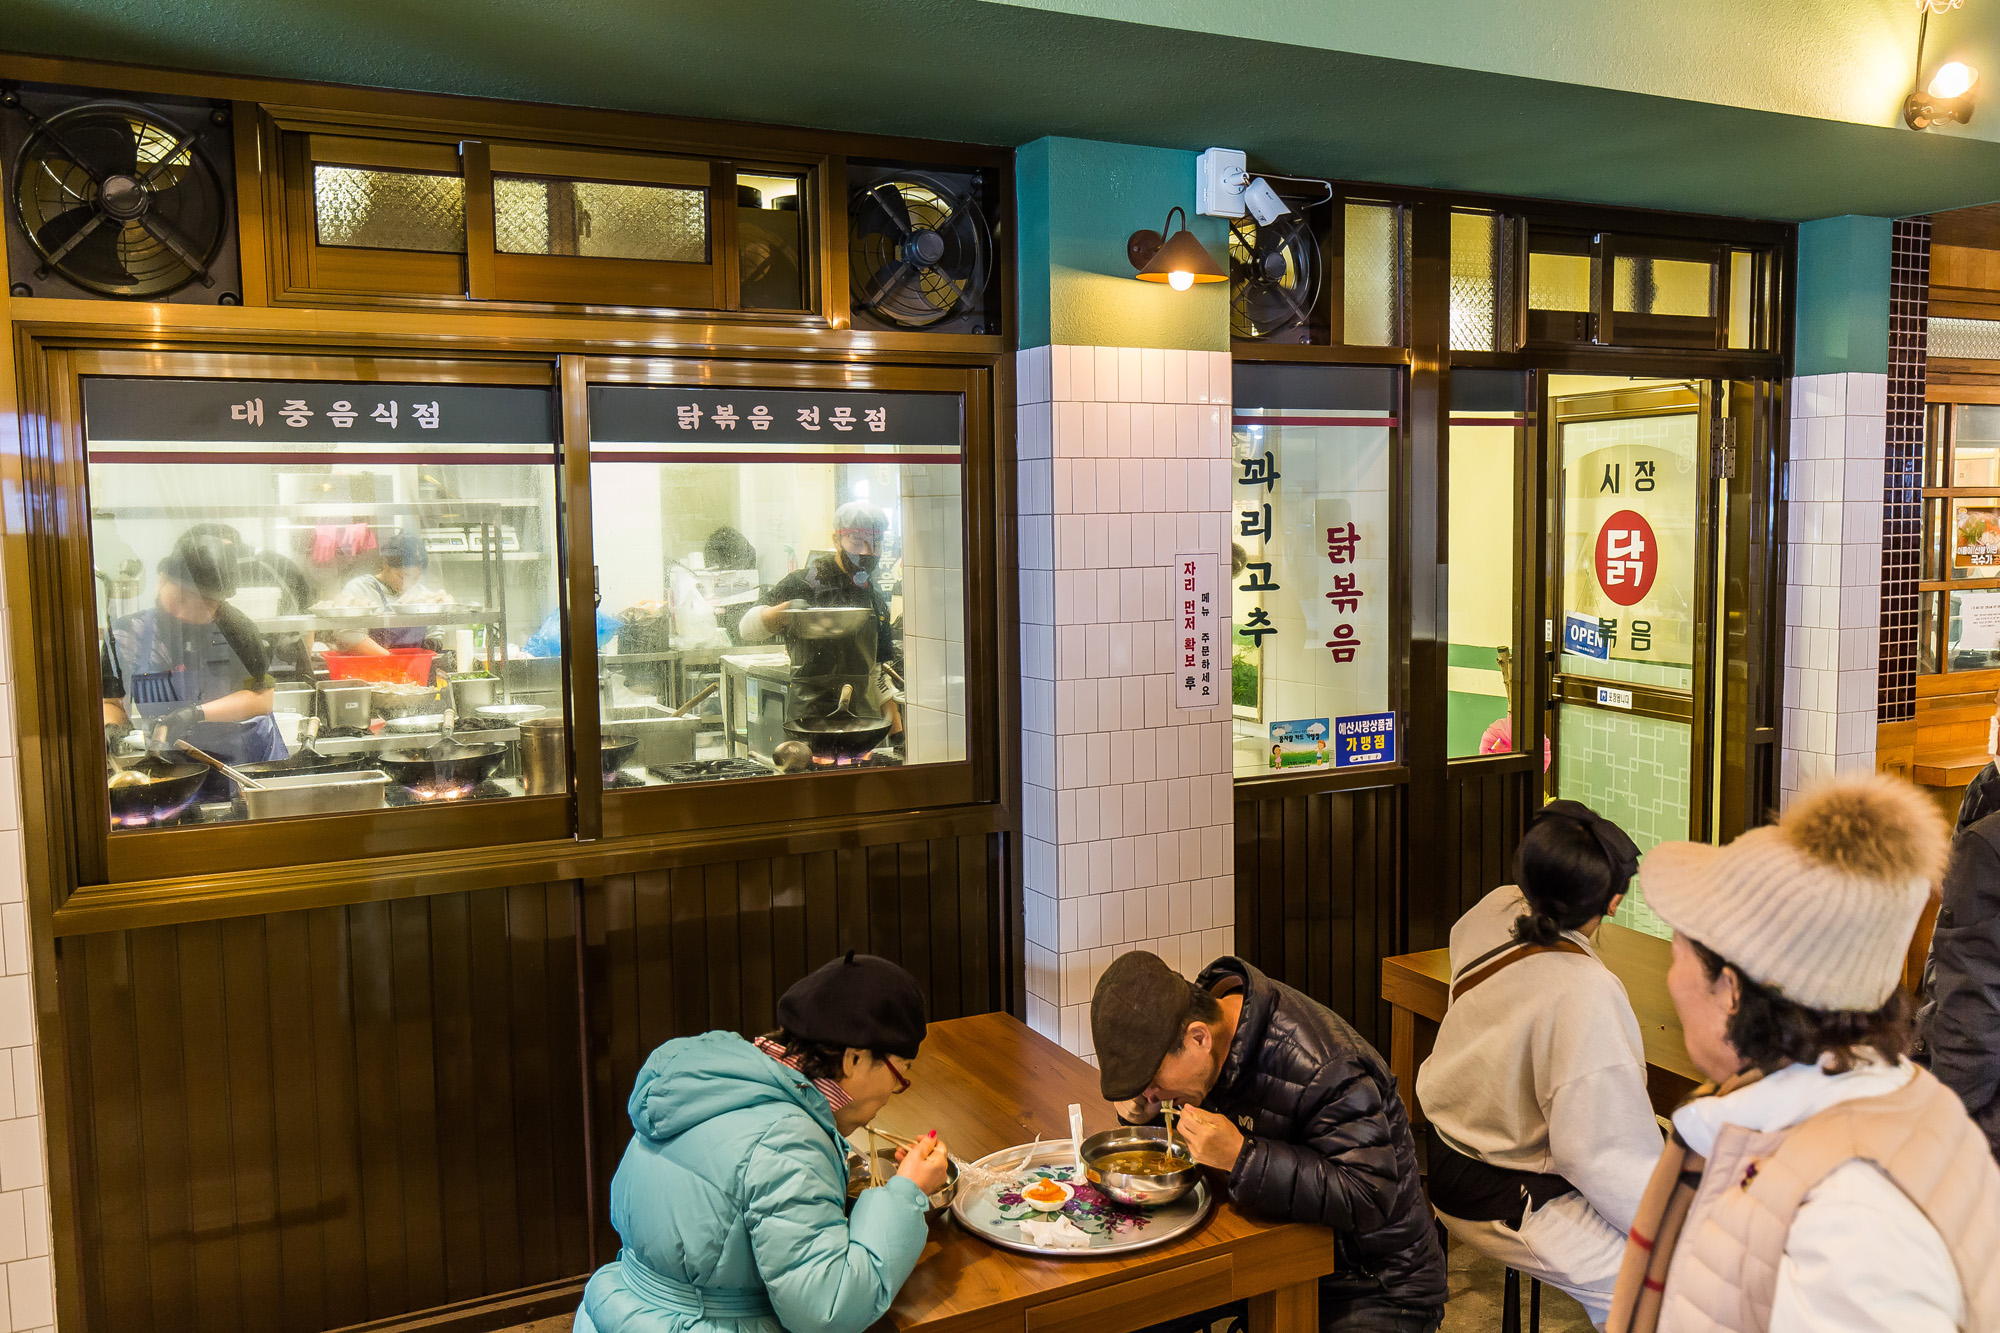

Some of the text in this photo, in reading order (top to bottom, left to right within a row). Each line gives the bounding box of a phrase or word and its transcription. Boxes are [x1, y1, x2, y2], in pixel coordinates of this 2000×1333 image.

[231, 399, 441, 429] 대중음식점
[677, 403, 886, 432] 닭볶음 전문점
[1600, 461, 1656, 494] 시장
[1238, 451, 1281, 648] 꽈리고추
[1607, 529, 1645, 587] 닭
[1971, 554, 1993, 565] 국수가
[1325, 522, 1364, 664] 닭볶음
[1184, 561, 1196, 691] 자리 먼저 확보 후
[1570, 624, 1603, 649] OPEN
[1599, 617, 1652, 651] 볶음
[1201, 592, 1210, 696] 메뉴 주문하세요
[1338, 717, 1393, 735] 예산사랑상품권
[1346, 734, 1385, 752] 가맹점
